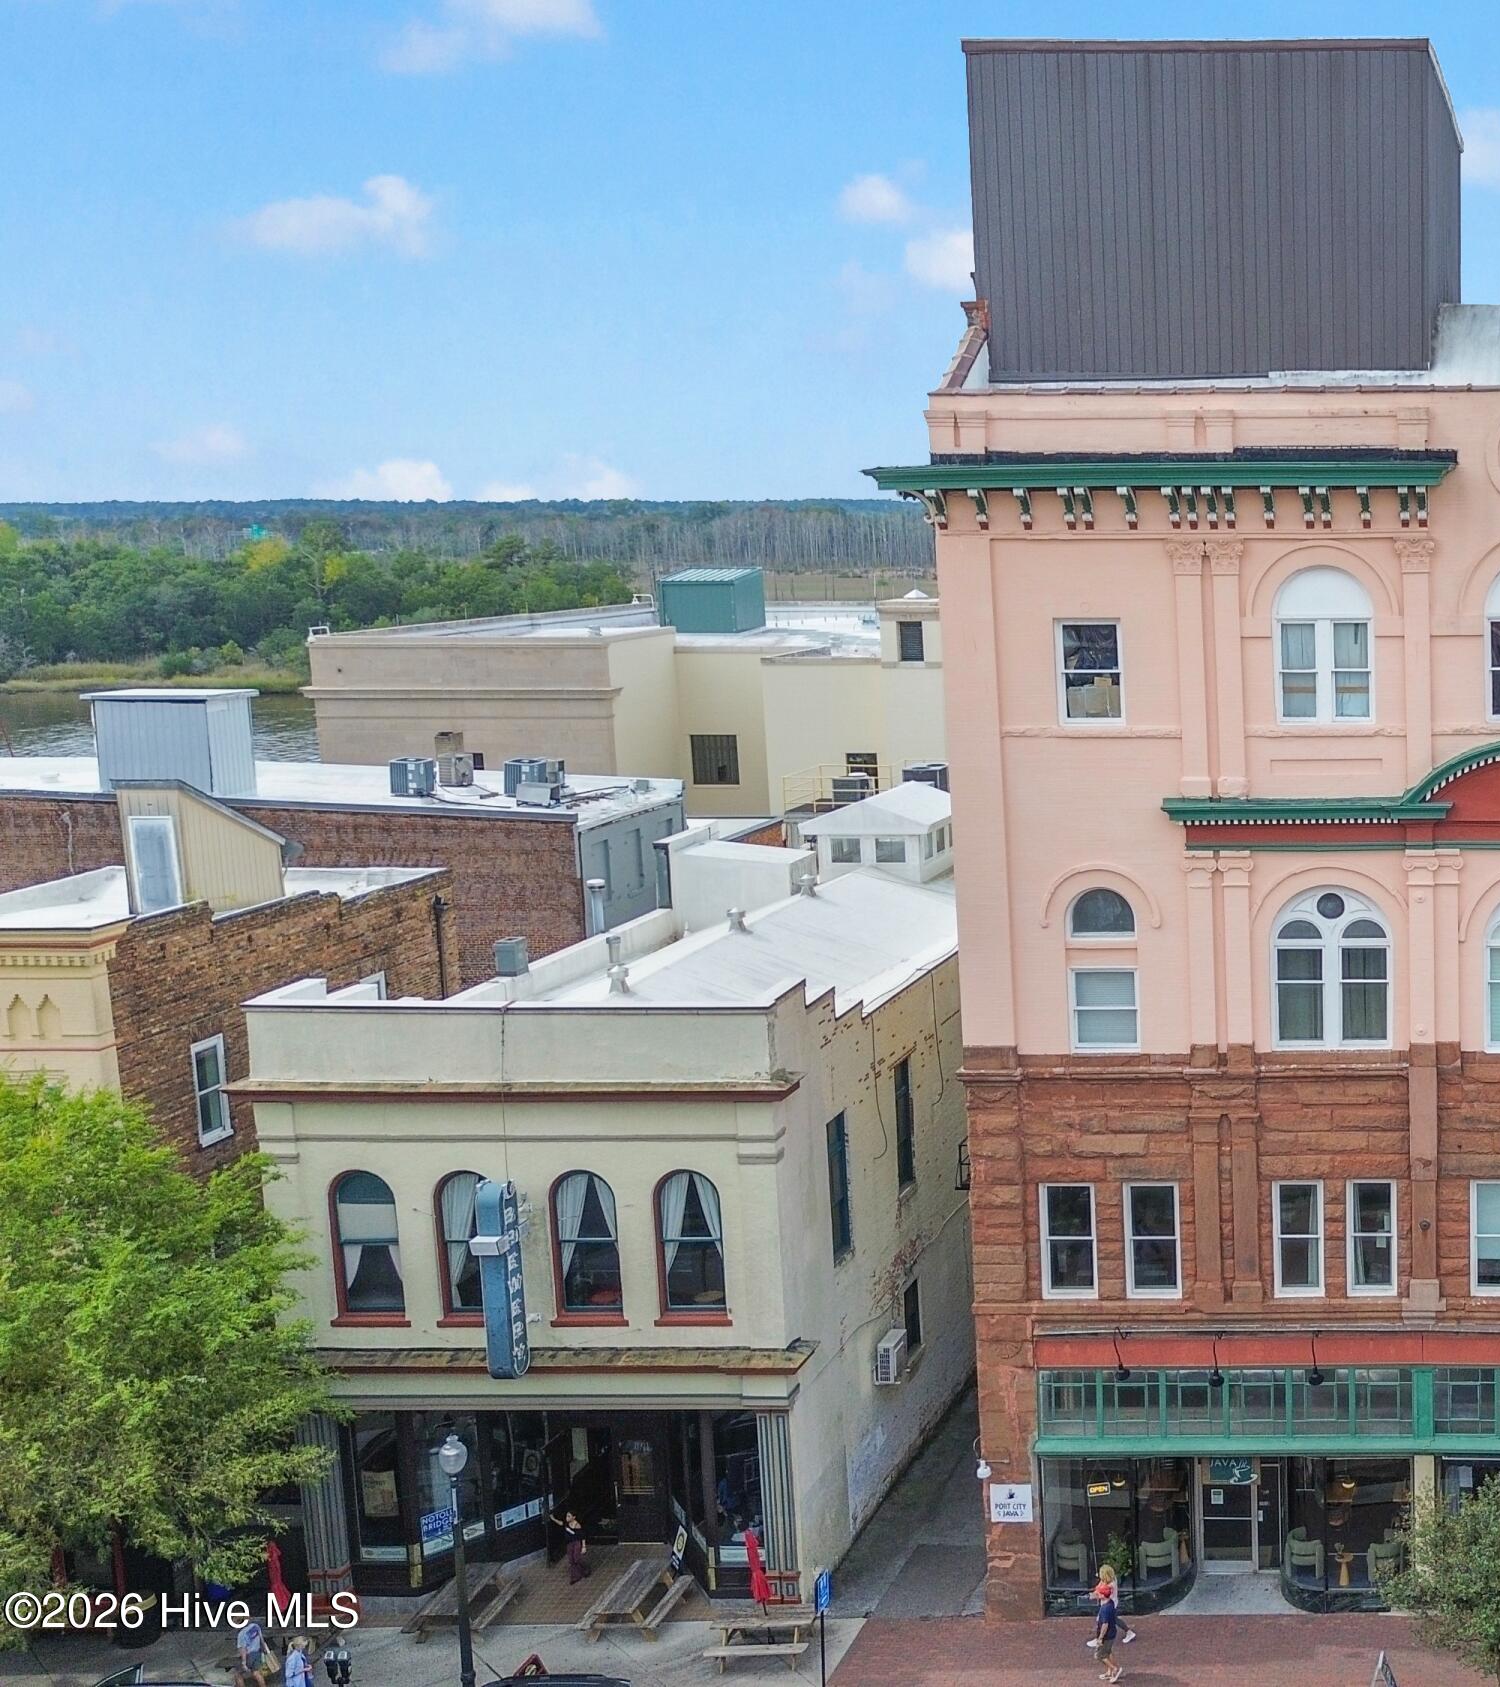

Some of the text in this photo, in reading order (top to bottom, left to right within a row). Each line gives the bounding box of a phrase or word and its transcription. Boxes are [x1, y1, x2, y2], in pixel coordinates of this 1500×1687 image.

[1209, 1458, 1237, 1467] JAVA
[1089, 1485, 1108, 1494] OPEN
[1002, 1510, 1019, 1518] JAVA
